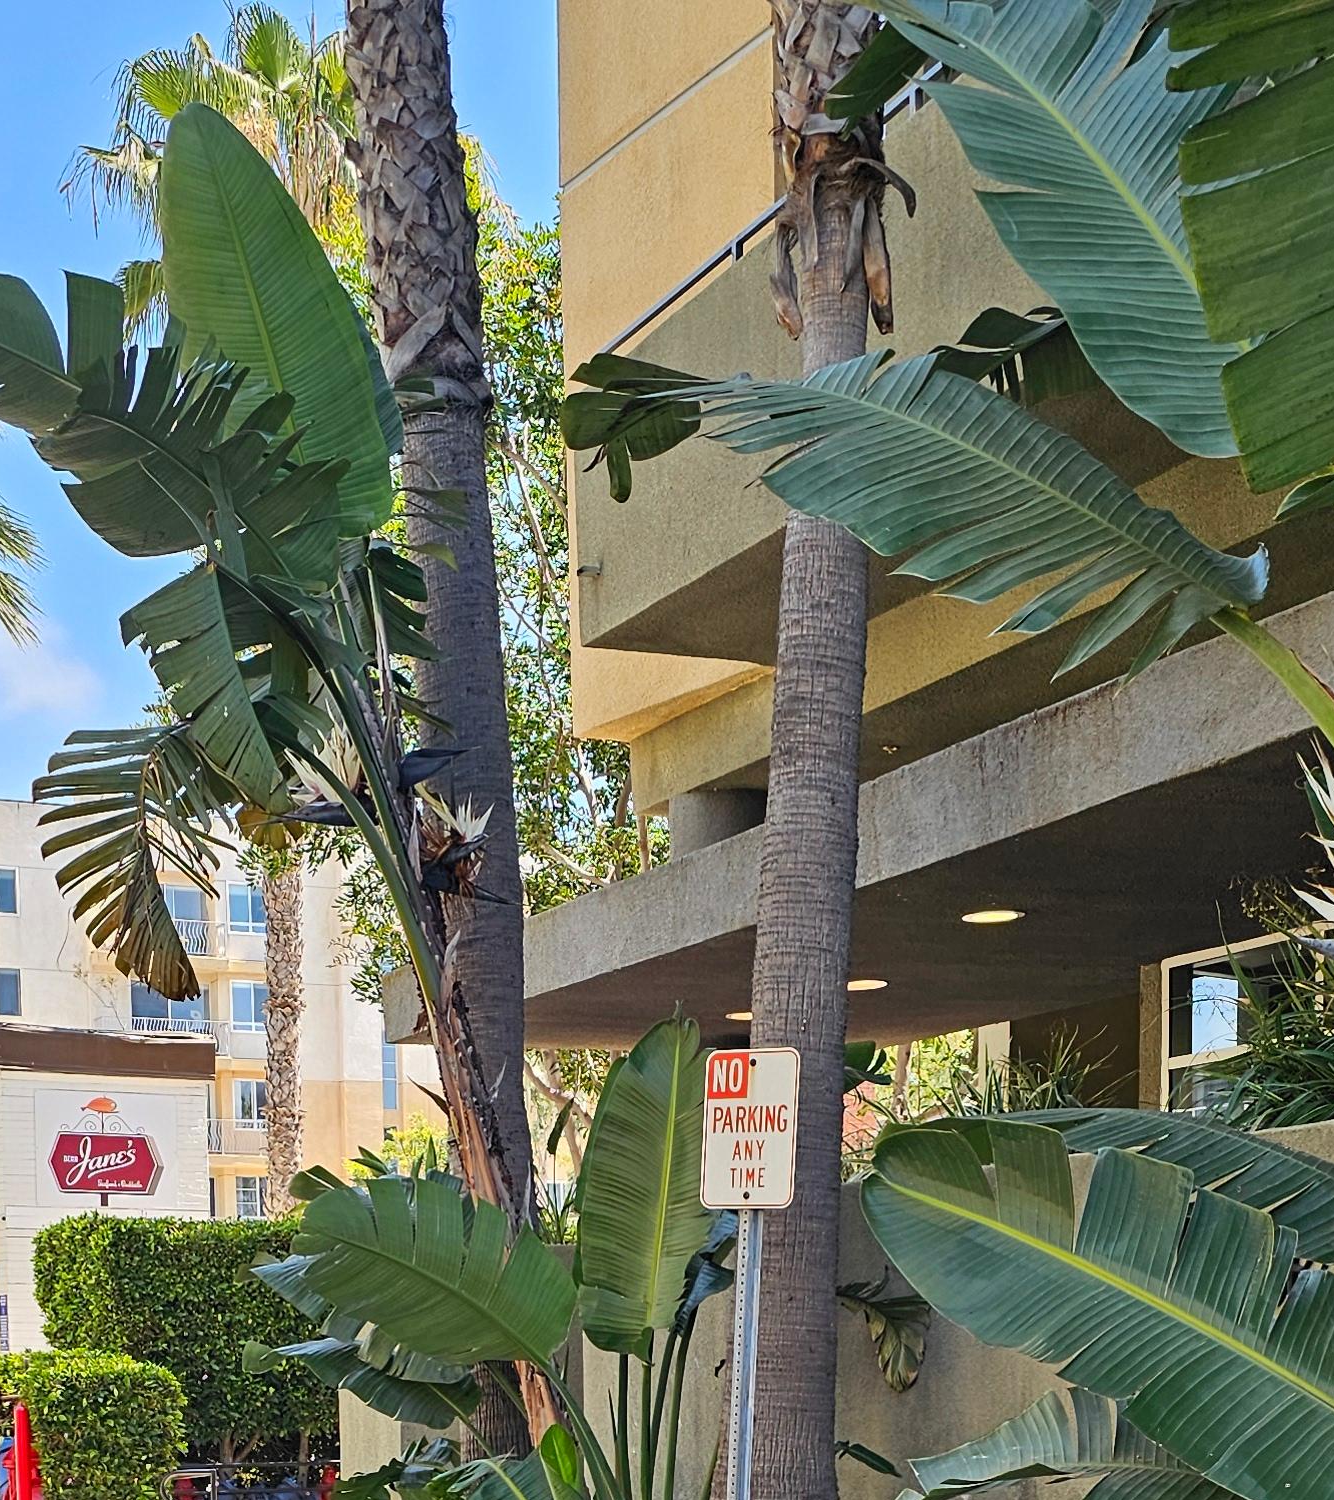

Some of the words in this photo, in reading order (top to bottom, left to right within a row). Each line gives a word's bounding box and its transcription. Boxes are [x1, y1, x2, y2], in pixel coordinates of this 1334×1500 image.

[712, 1057, 744, 1093] NO
[712, 1104, 788, 1134] PARKING
[65, 1136, 137, 1185] Jane's
[732, 1140, 765, 1161] ANY
[730, 1167, 766, 1188] TIME
